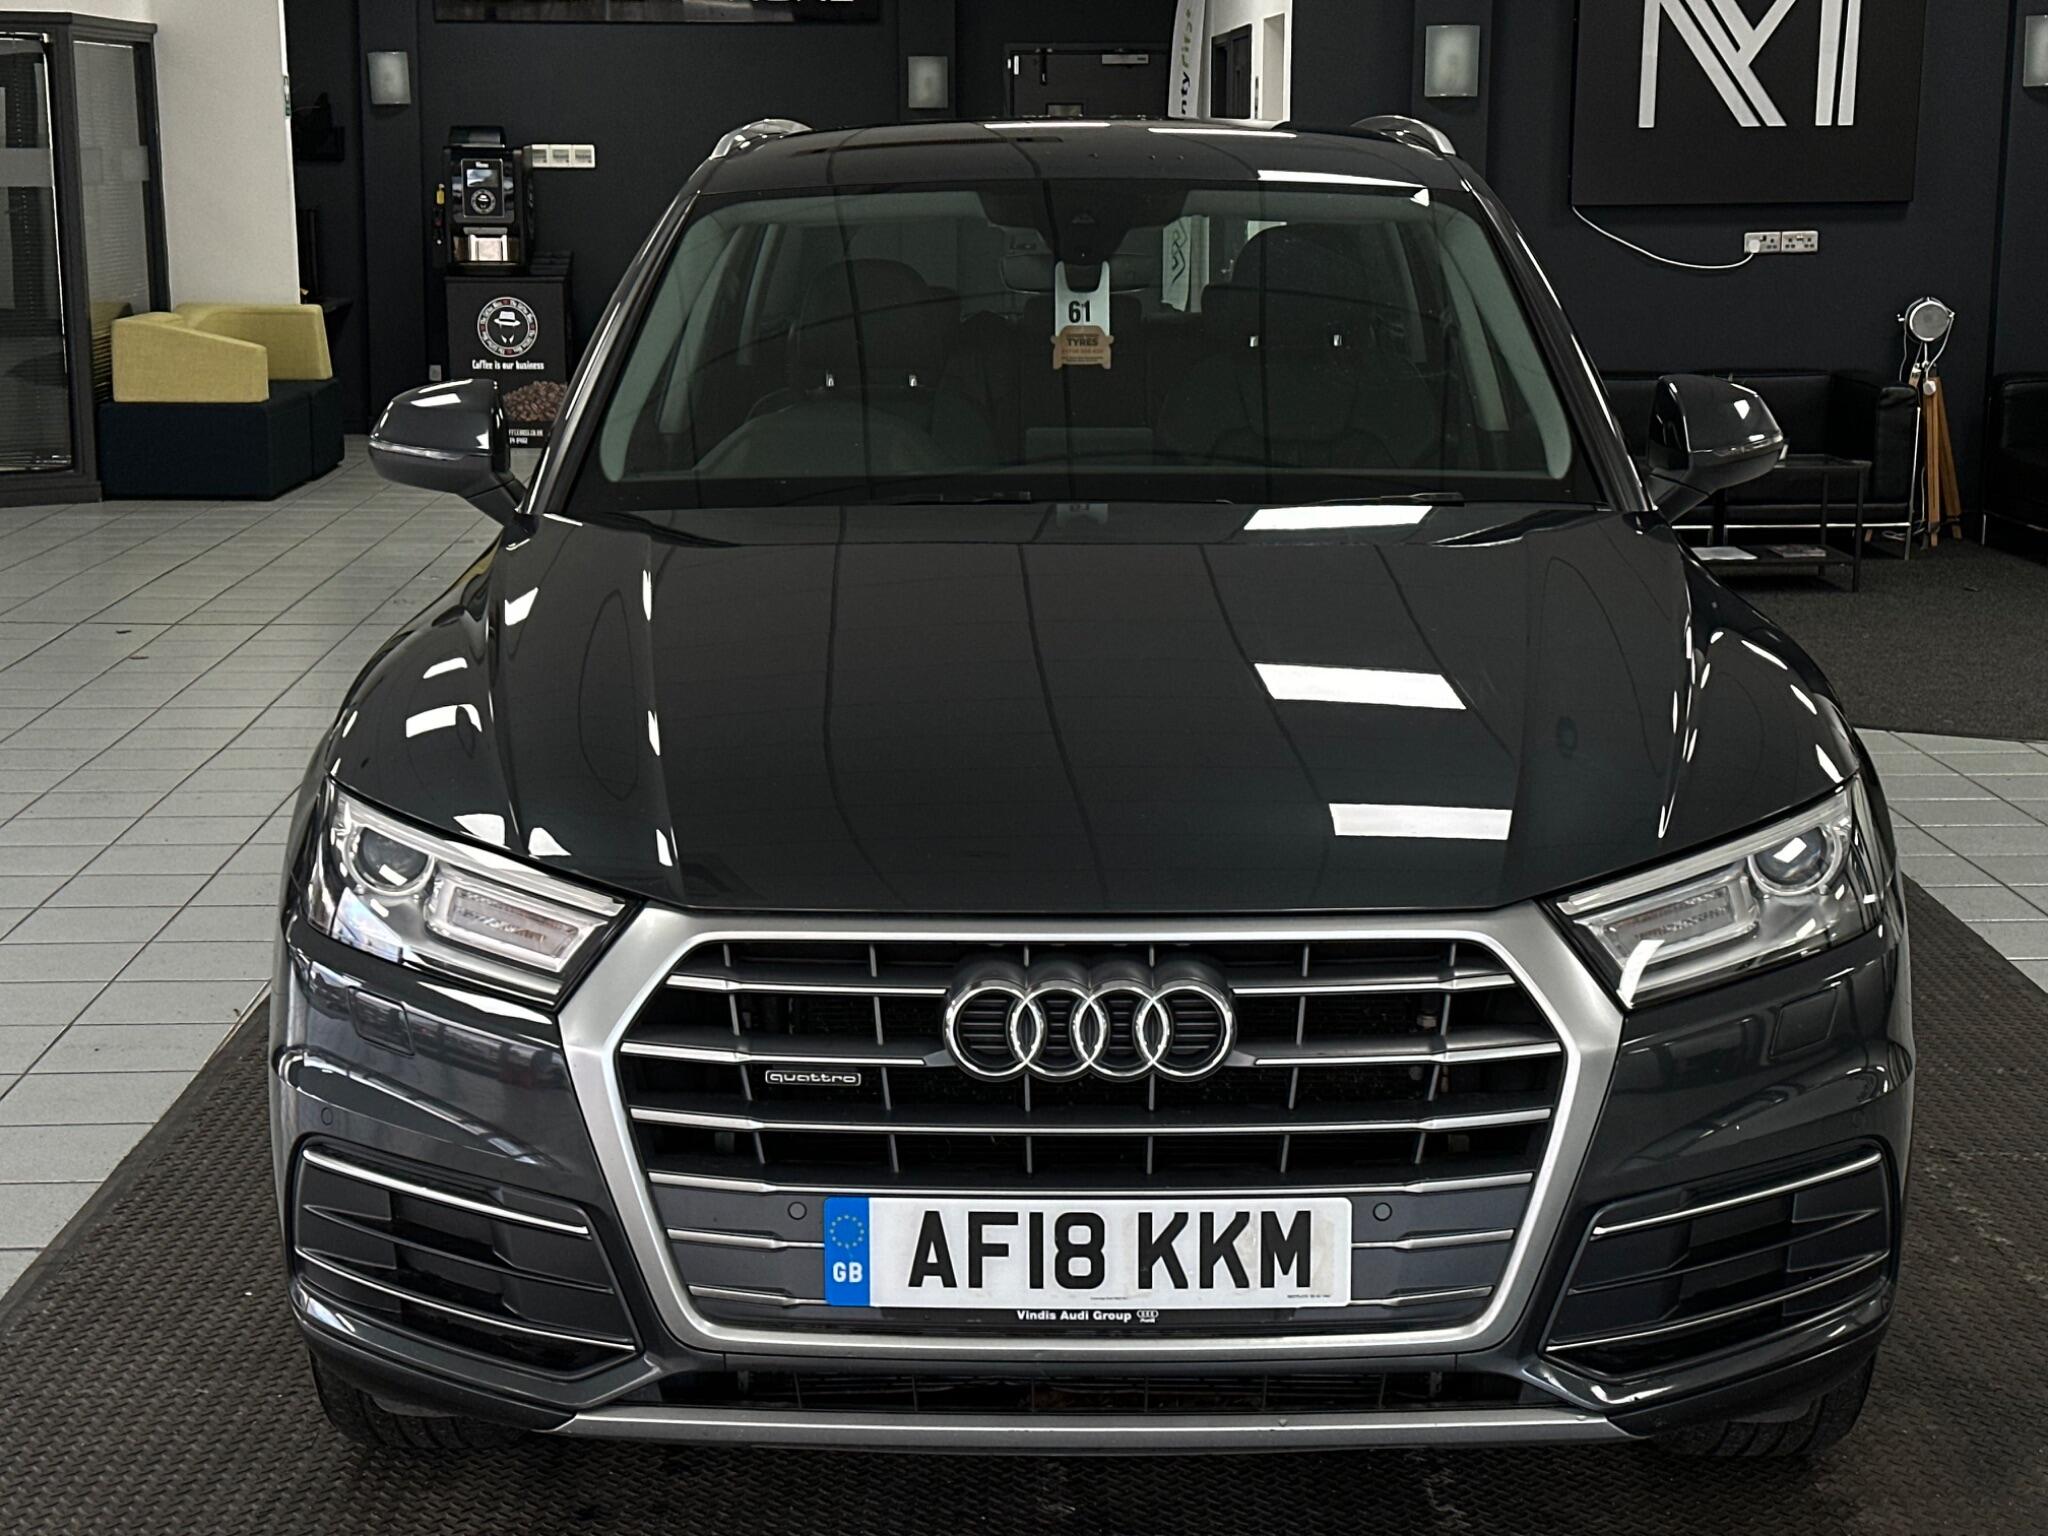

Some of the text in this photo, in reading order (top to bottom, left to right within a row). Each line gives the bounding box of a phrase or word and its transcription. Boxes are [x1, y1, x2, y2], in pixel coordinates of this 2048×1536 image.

[1068, 300, 1091, 323] 61
[1067, 336, 1099, 346] TYRES
[472, 359, 493, 370] Coffee
[515, 360, 545, 370] business
[769, 1073, 857, 1083] quattro
[908, 1210, 1311, 1290] AF18 KKM
[832, 1261, 863, 1283] GB
[1017, 1310, 1132, 1323] Vindis Audi Group
